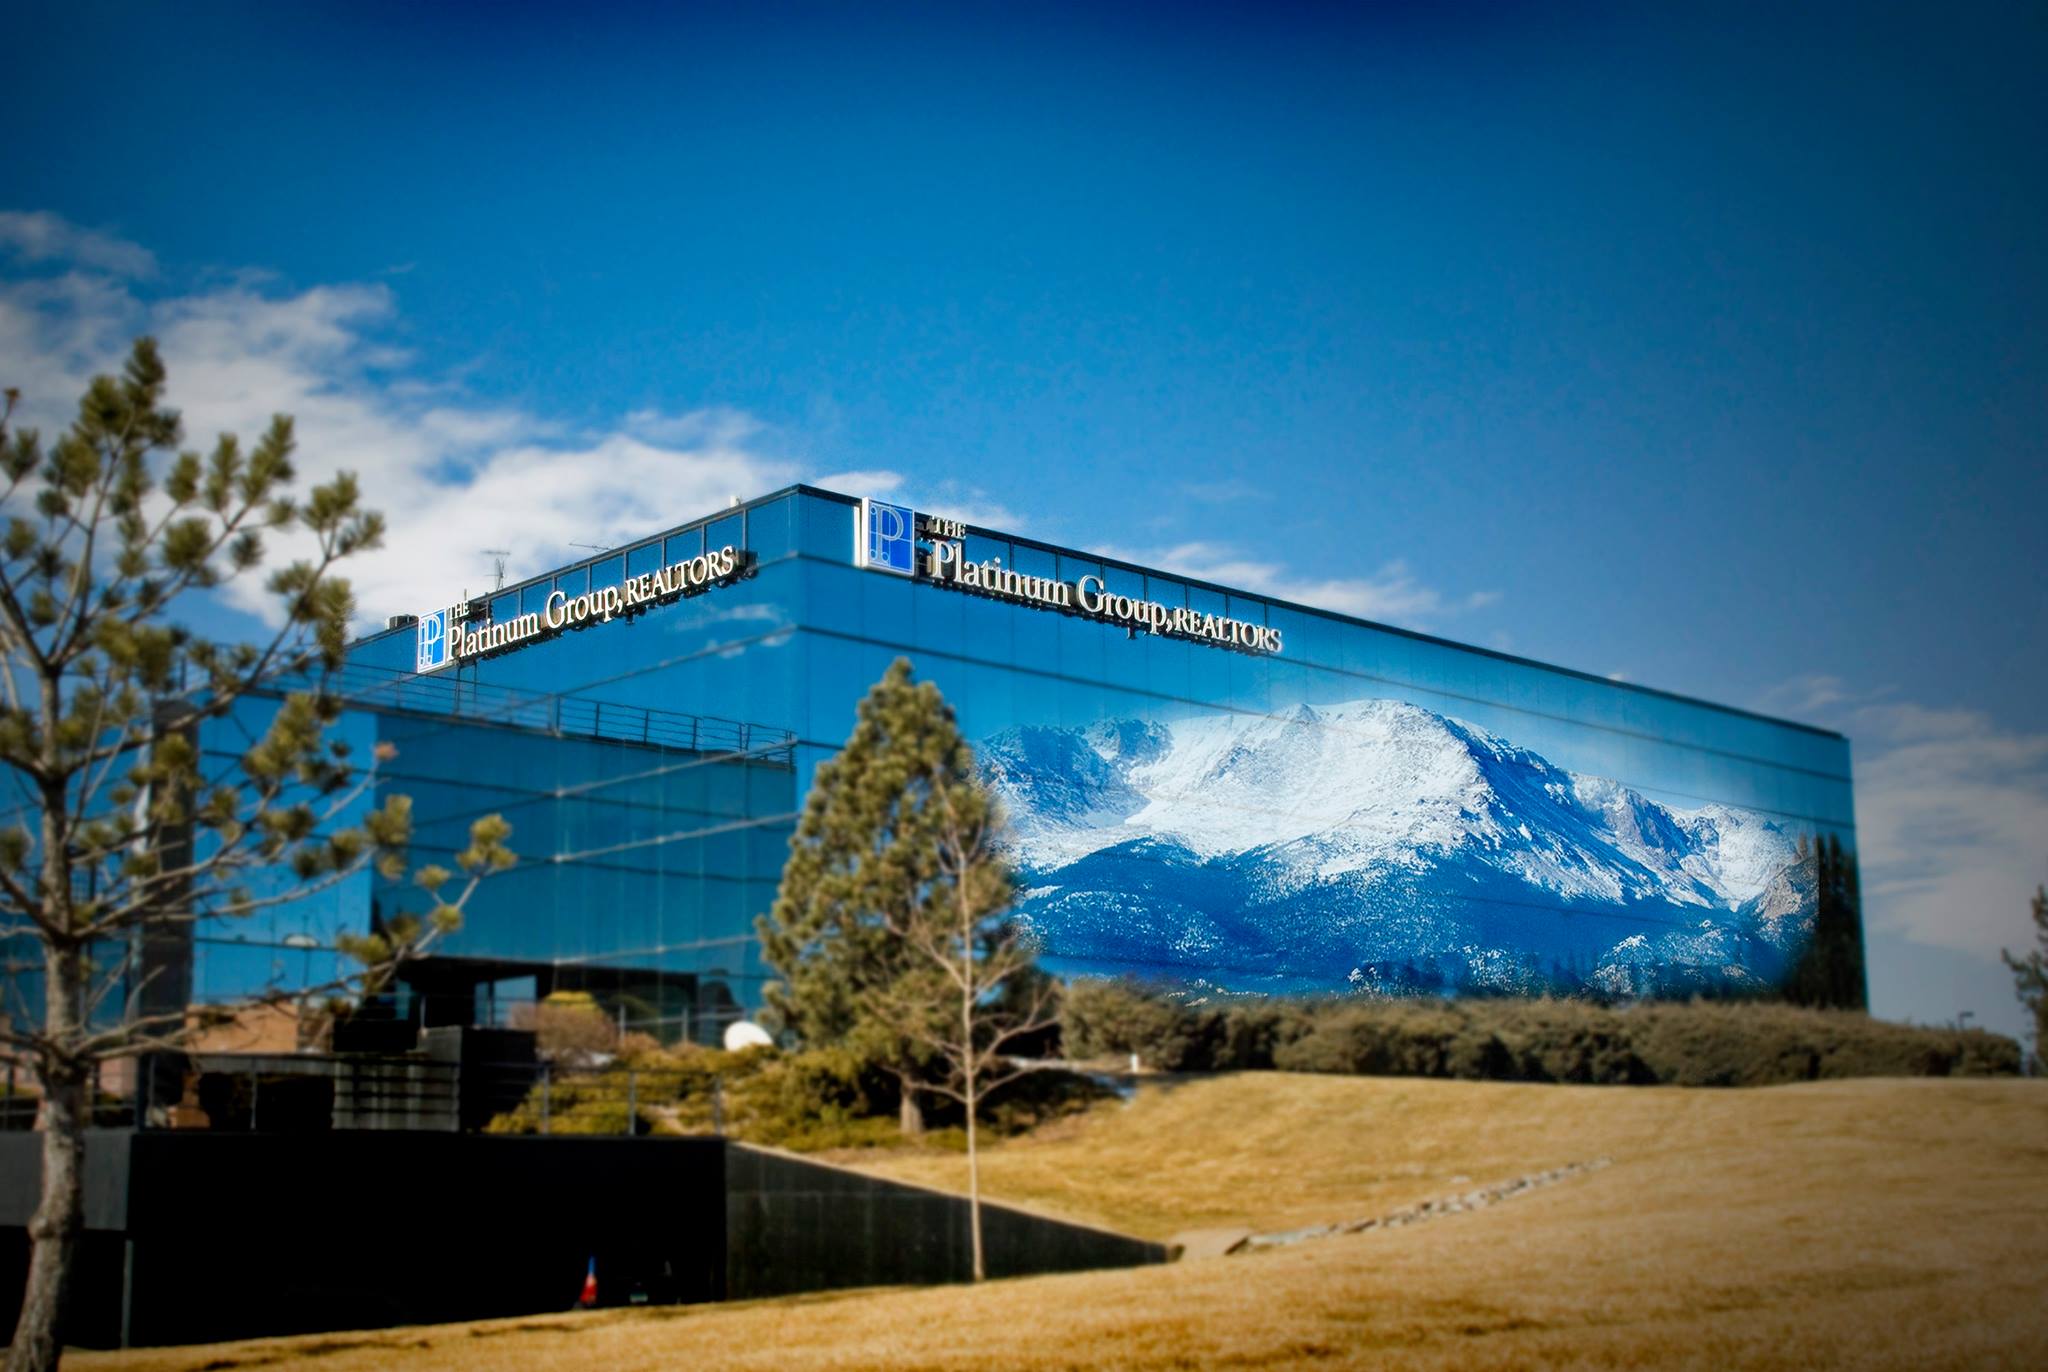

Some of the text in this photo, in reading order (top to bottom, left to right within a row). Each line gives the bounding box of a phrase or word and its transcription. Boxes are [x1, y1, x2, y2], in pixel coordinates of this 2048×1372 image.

[934, 517, 966, 539] THE
[446, 546, 734, 662] Platinum Group, REALTORS
[448, 601, 469, 621] THE
[932, 539, 1282, 653] Platinum Group, REALTORS
